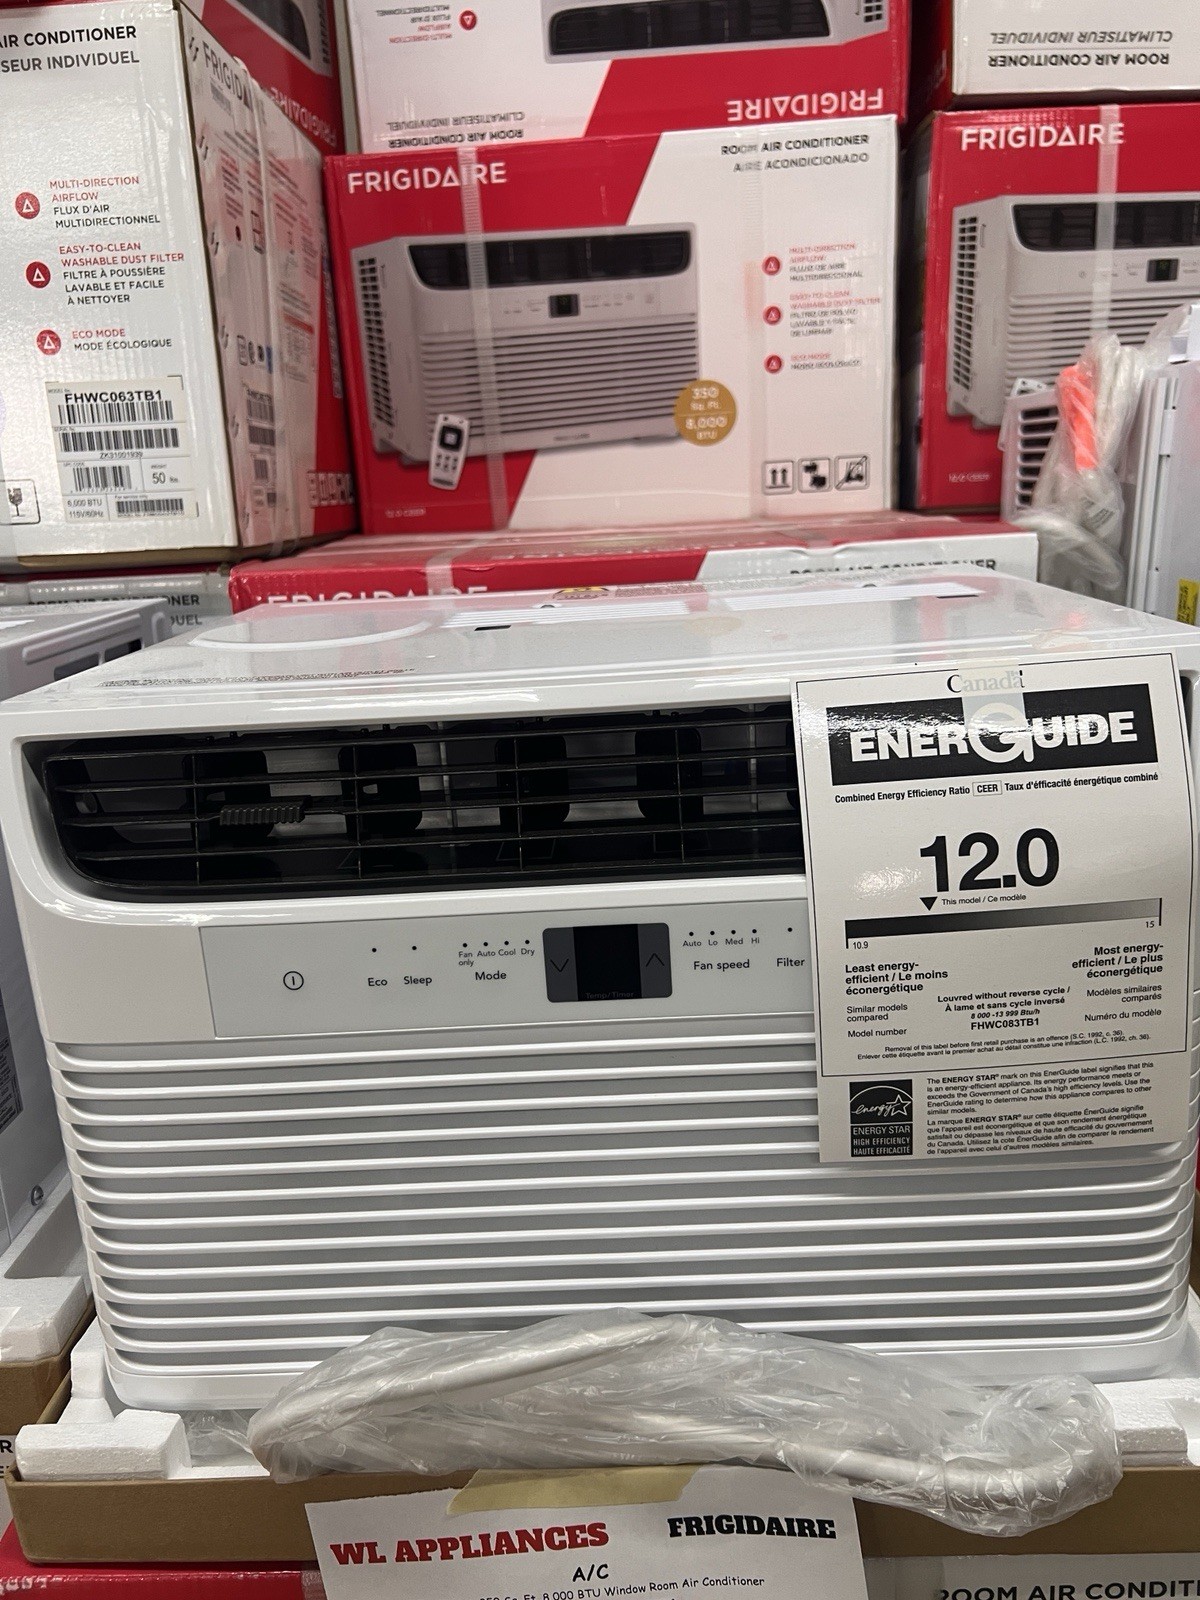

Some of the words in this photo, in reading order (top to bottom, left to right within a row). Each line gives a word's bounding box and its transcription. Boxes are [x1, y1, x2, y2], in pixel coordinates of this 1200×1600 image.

[24, 25, 137, 46] CONDITIONER
[990, 32, 1074, 45] INDIVIDUEL
[1078, 31, 1173, 43] CLIMATISEUR
[47, 50, 140, 69] INDIVIDUEL
[988, 54, 1090, 67] CONDITIONER
[1095, 54, 1119, 66] AIR
[1125, 53, 1169, 65] ROOM
[726, 88, 883, 122] FRIGIDAIRE
[467, 132, 486, 142] AIR
[489, 129, 524, 139] ROOM
[961, 123, 1125, 151] FRIGIDAIRE
[388, 134, 466, 148] CONDITIONER
[721, 144, 758, 155] ROOM
[761, 141, 782, 152] AIR
[785, 134, 870, 150] CONDITIONER
[764, 152, 870, 170] ACONDICIONADO
[49, 176, 140, 190] MULTI-DIRECTION
[347, 162, 508, 194] FRIGIDAIRE
[52, 192, 99, 203] AIRFLOW
[53, 206, 79, 216] FLUX
[82, 204, 110, 214] D'AIR
[55, 215, 161, 228] MULTIDIRECTIONNEL
[59, 242, 141, 254] EASY-TO-CLEAN
[61, 256, 118, 267] WASHABLE
[121, 254, 147, 265] DUST
[150, 253, 184, 263] FILTER
[63, 270, 97, 280] FILTRE
[100, 268, 108, 278] À
[110, 266, 166, 277] POUSSIÈRE
[65, 282, 111, 293] LAVABLE
[114, 281, 126, 290] ET
[129, 280, 165, 289] FACILE
[67, 296, 75, 305] À
[77, 294, 130, 305] NETTOYER
[72, 330, 93, 339] ECO
[96, 328, 126, 338] MODE
[74, 342, 103, 351] MODE
[106, 338, 173, 350] ÉCOLOGIQUE
[64, 390, 162, 404] FHWC063TB1
[152, 472, 166, 484] 50
[946, 670, 1025, 693] Canada
[834, 792, 876, 803] Combined
[877, 791, 905, 801] Energy
[907, 788, 947, 798] Efficiency
[949, 786, 970, 795] Ratio
[976, 784, 999, 793] CEER
[1004, 783, 1024, 791] Taux
[1026, 779, 1072, 789] d'éfficacité
[1073, 776, 1122, 787] énergétique
[1123, 772, 1159, 783] combiné
[920, 828, 1060, 892] 12.0
[958, 896, 981, 904] model
[987, 895, 999, 903] Ce
[999, 894, 1027, 902] modèle
[1145, 920, 1155, 929] 15
[853, 941, 869, 950] 10.9
[1094, 945, 1121, 956] Most
[1122, 943, 1164, 953] energy-
[520, 948, 535, 957] Dry
[458, 959, 474, 967] only
[693, 961, 713, 970] Fan
[716, 959, 750, 972] speed
[776, 957, 805, 967] Filter
[1072, 957, 1115, 968] efficient
[1117, 956, 1122, 965] /
[1124, 955, 1137, 964] Le
[1140, 953, 1163, 965] plus
[845, 963, 875, 973] Least
[877, 962, 919, 972] energy-
[1087, 965, 1163, 978] éconergétique
[403, 976, 433, 986] Sleep
[475, 970, 507, 981] Mode
[845, 973, 889, 984] efficient
[892, 972, 896, 982] /
[898, 972, 912, 981] Le
[914, 970, 949, 980] moins
[367, 977, 388, 987] Eco
[845, 983, 924, 995] éconergétique
[937, 993, 973, 1003] Louvred
[975, 991, 1007, 1000] without
[1008, 989, 1041, 997] reverse
[1042, 987, 1065, 996] cycle
[1086, 987, 1122, 997] Modèles
[1123, 984, 1162, 994] similaires
[1121, 993, 1162, 1003] comparés
[846, 1005, 875, 1014] Similar
[877, 1003, 908, 1012] models
[945, 1003, 952, 1012] À
[954, 1003, 974, 1011] lame
[1009, 999, 1032, 1009] cycle
[1034, 997, 1065, 1006] inversé
[846, 1013, 889, 1023] compared
[1020, 1008, 1041, 1016] Btu/h
[1084, 1012, 1117, 1021] Numéro
[1119, 1011, 1130, 1019] du
[1131, 1009, 1162, 1017] modèle
[970, 1018, 1039, 1030] FHWC083TB1
[847, 1029, 873, 1038] Model
[875, 1028, 907, 1037] number
[1043, 1069, 1080, 1077] EnerGuide
[853, 1126, 887, 1136] ENERGY
[888, 1125, 911, 1135] STAR
[853, 1138, 870, 1146] HIGH
[872, 1136, 910, 1145] EFFICIENCY
[853, 1147, 875, 1155] HAUTE
[667, 1514, 837, 1539] FRIGIDAIRE
[330, 1541, 387, 1565] WL
[395, 1522, 610, 1563] APPLIANCES
[572, 1563, 609, 1582] A/C
[577, 1588, 601, 1599] BTU
[604, 1584, 646, 1597] Window
[649, 1582, 678, 1592] Room
[682, 1578, 699, 1588] Air
[702, 1576, 765, 1587] Conditioner
[1028, 1584, 1076, 1600] AIR
